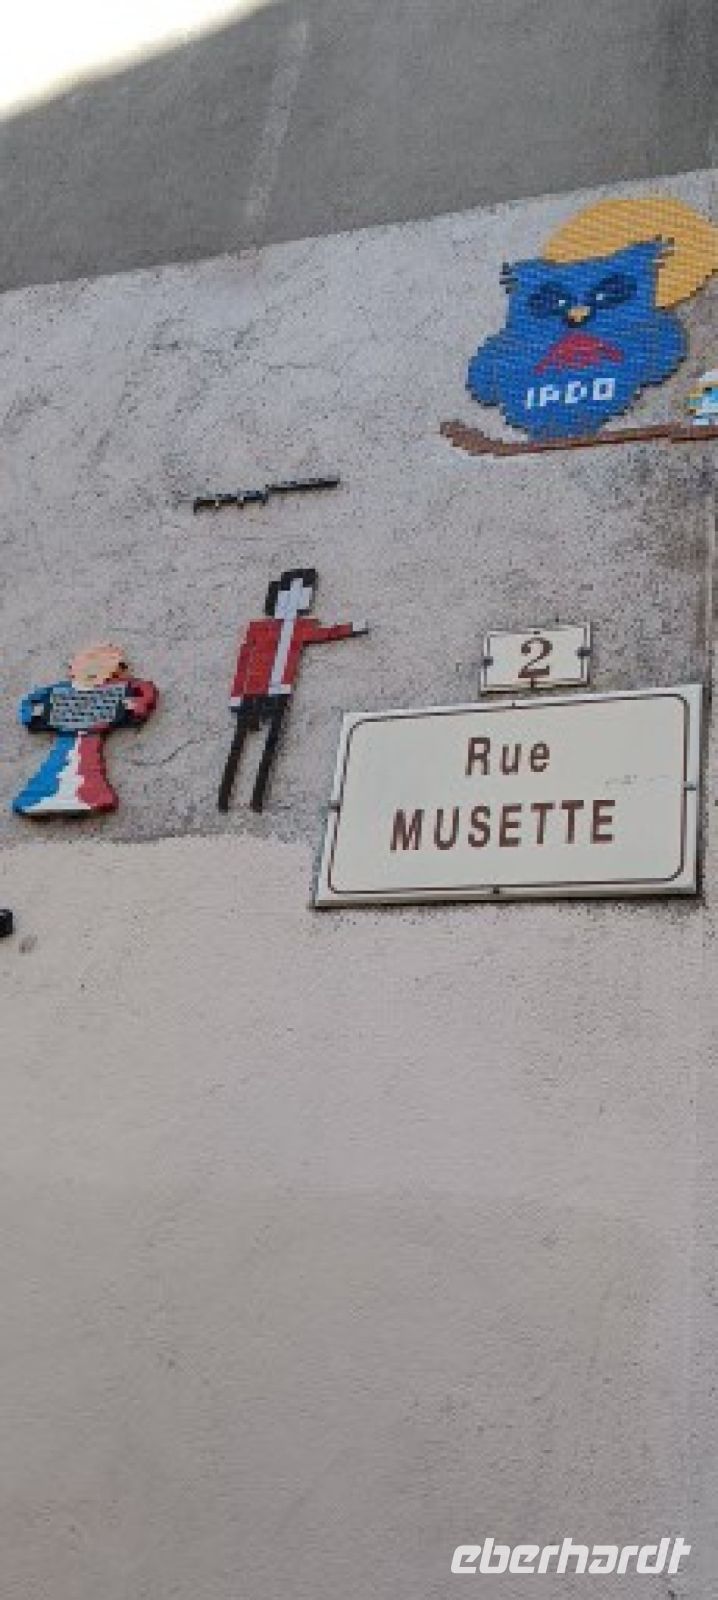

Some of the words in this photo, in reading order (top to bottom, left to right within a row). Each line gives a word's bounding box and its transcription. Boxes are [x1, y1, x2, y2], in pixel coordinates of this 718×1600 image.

[517, 637, 553, 679] 2
[465, 737, 551, 776] Rue
[389, 799, 616, 851] MUSETTE
